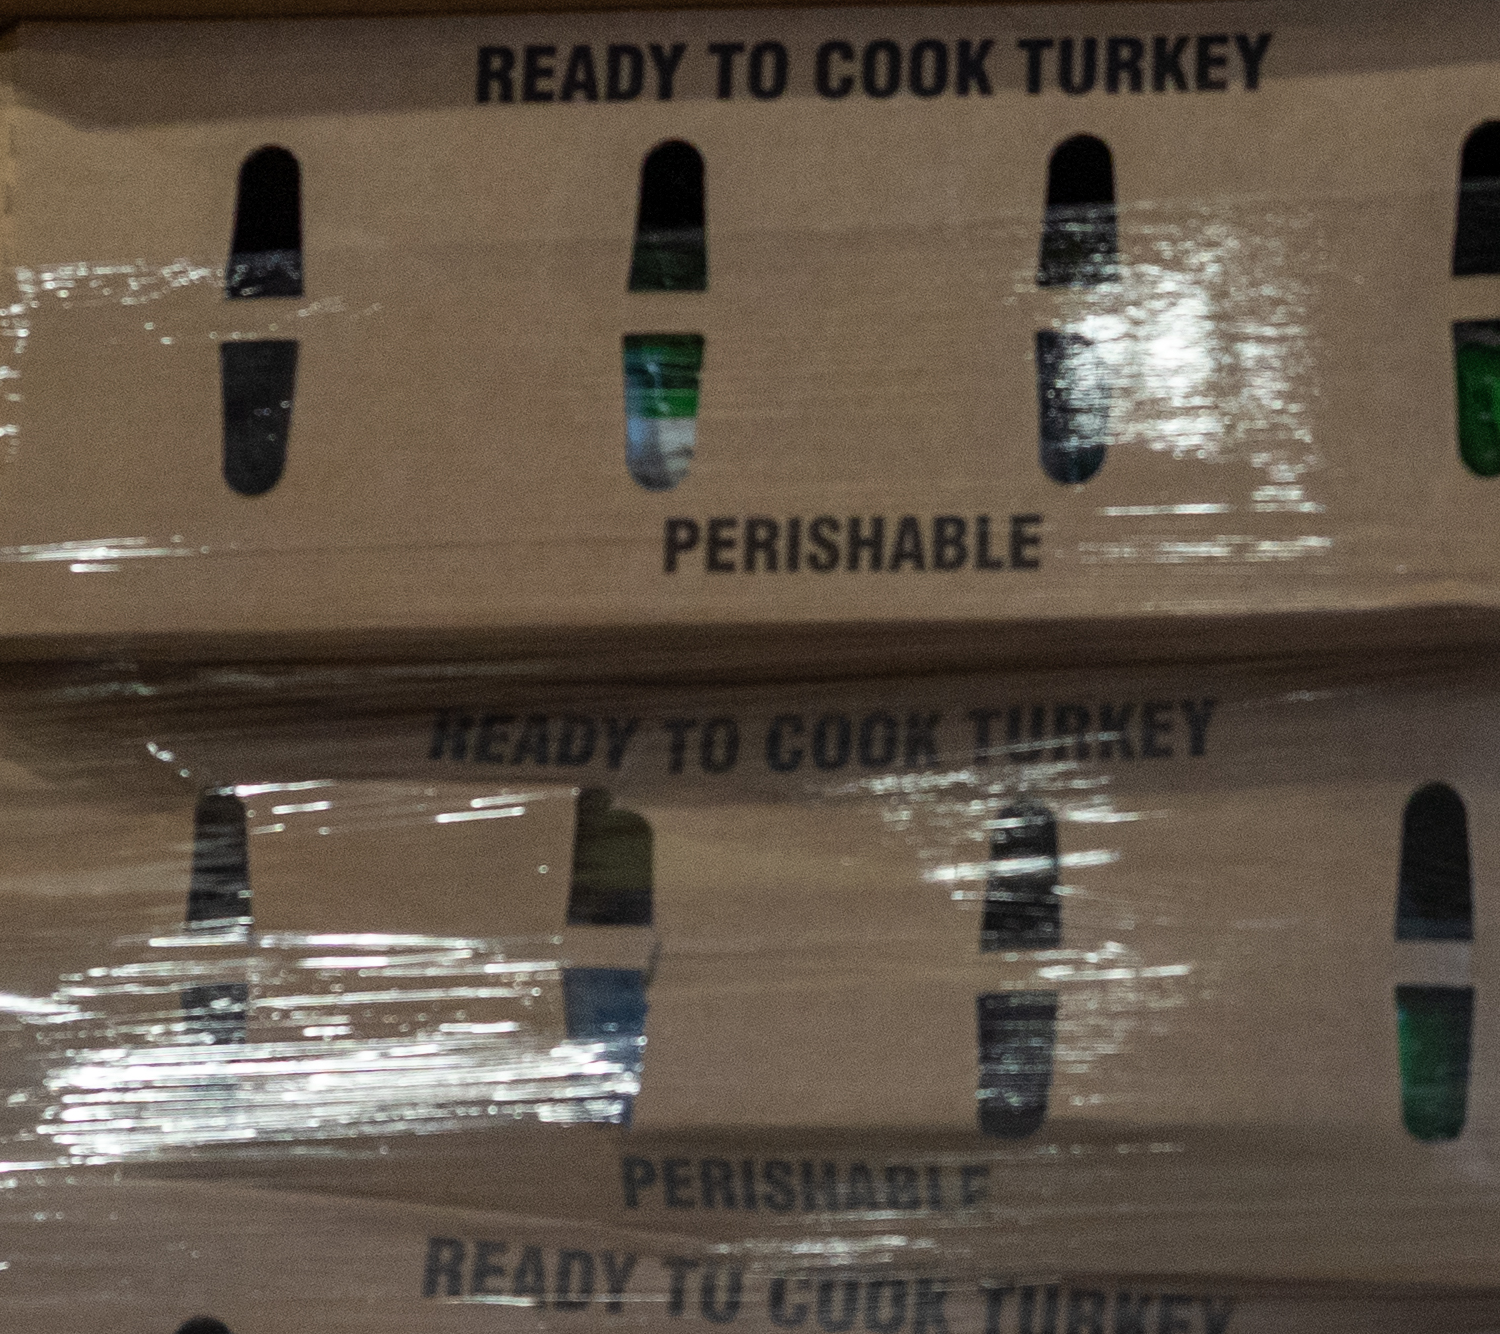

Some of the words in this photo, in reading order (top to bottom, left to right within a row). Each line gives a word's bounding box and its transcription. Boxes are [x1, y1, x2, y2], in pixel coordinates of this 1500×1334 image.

[476, 42, 689, 104] READY
[708, 40, 790, 101] TO
[814, 37, 996, 99] COOK
[1016, 31, 1275, 96] TURKEY
[661, 513, 1043, 575] PERISHABLE
[429, 708, 642, 772] READY
[660, 713, 741, 774] TO
[764, 708, 943, 774] COOK
[967, 698, 1219, 767] TURKEY
[622, 1155, 992, 1217] PERISHABLE
[421, 1235, 644, 1315] READY
[662, 1252, 743, 1328] TO
